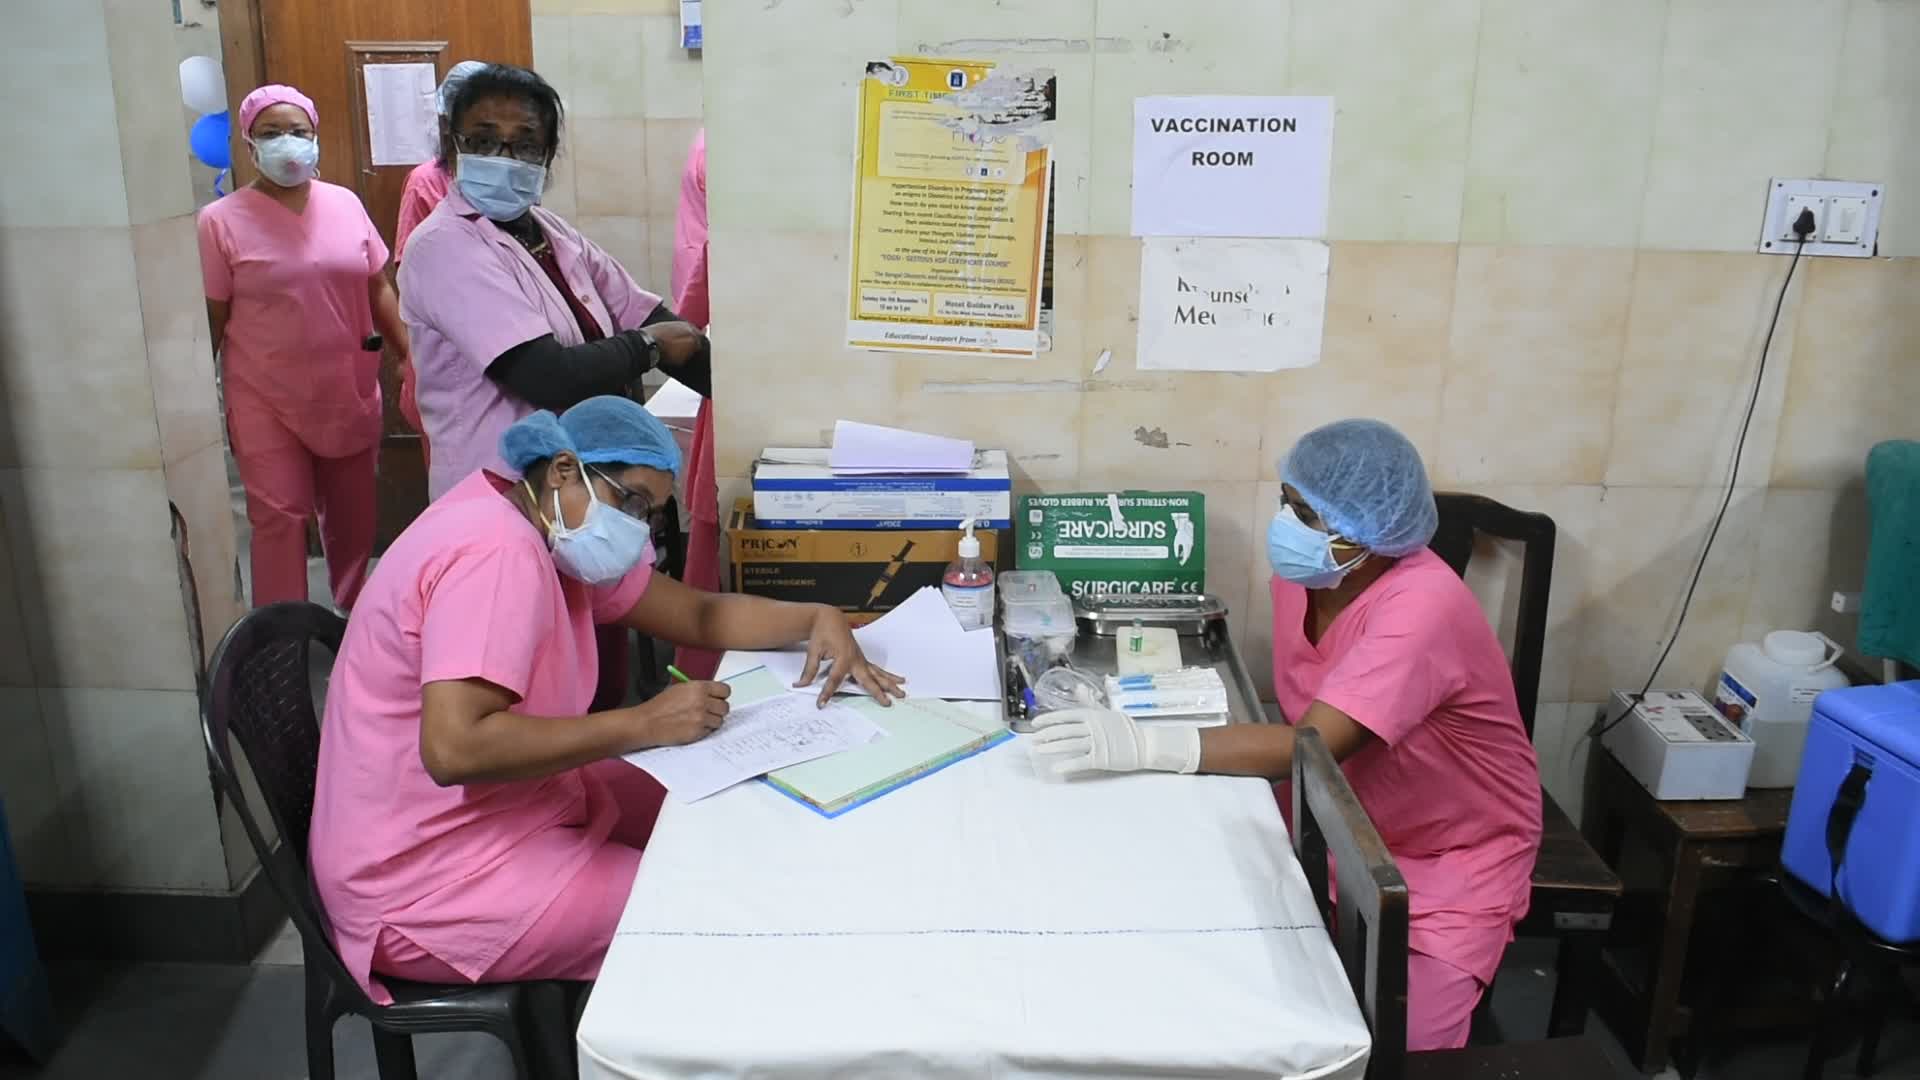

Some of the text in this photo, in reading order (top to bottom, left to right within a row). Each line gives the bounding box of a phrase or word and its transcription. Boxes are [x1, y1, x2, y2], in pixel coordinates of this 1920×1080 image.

[1151, 118, 1297, 133] VACCINATION
[1192, 151, 1254, 166] ROOM
[884, 331, 928, 340] Educational
[929, 334, 958, 344] support
[1028, 498, 1059, 506] GLOVES
[1061, 498, 1094, 506] RUBBER
[1135, 498, 1189, 507] NON-STERILE
[1058, 520, 1167, 539] SURGICARE
[1072, 580, 1175, 597] SURGICARE
